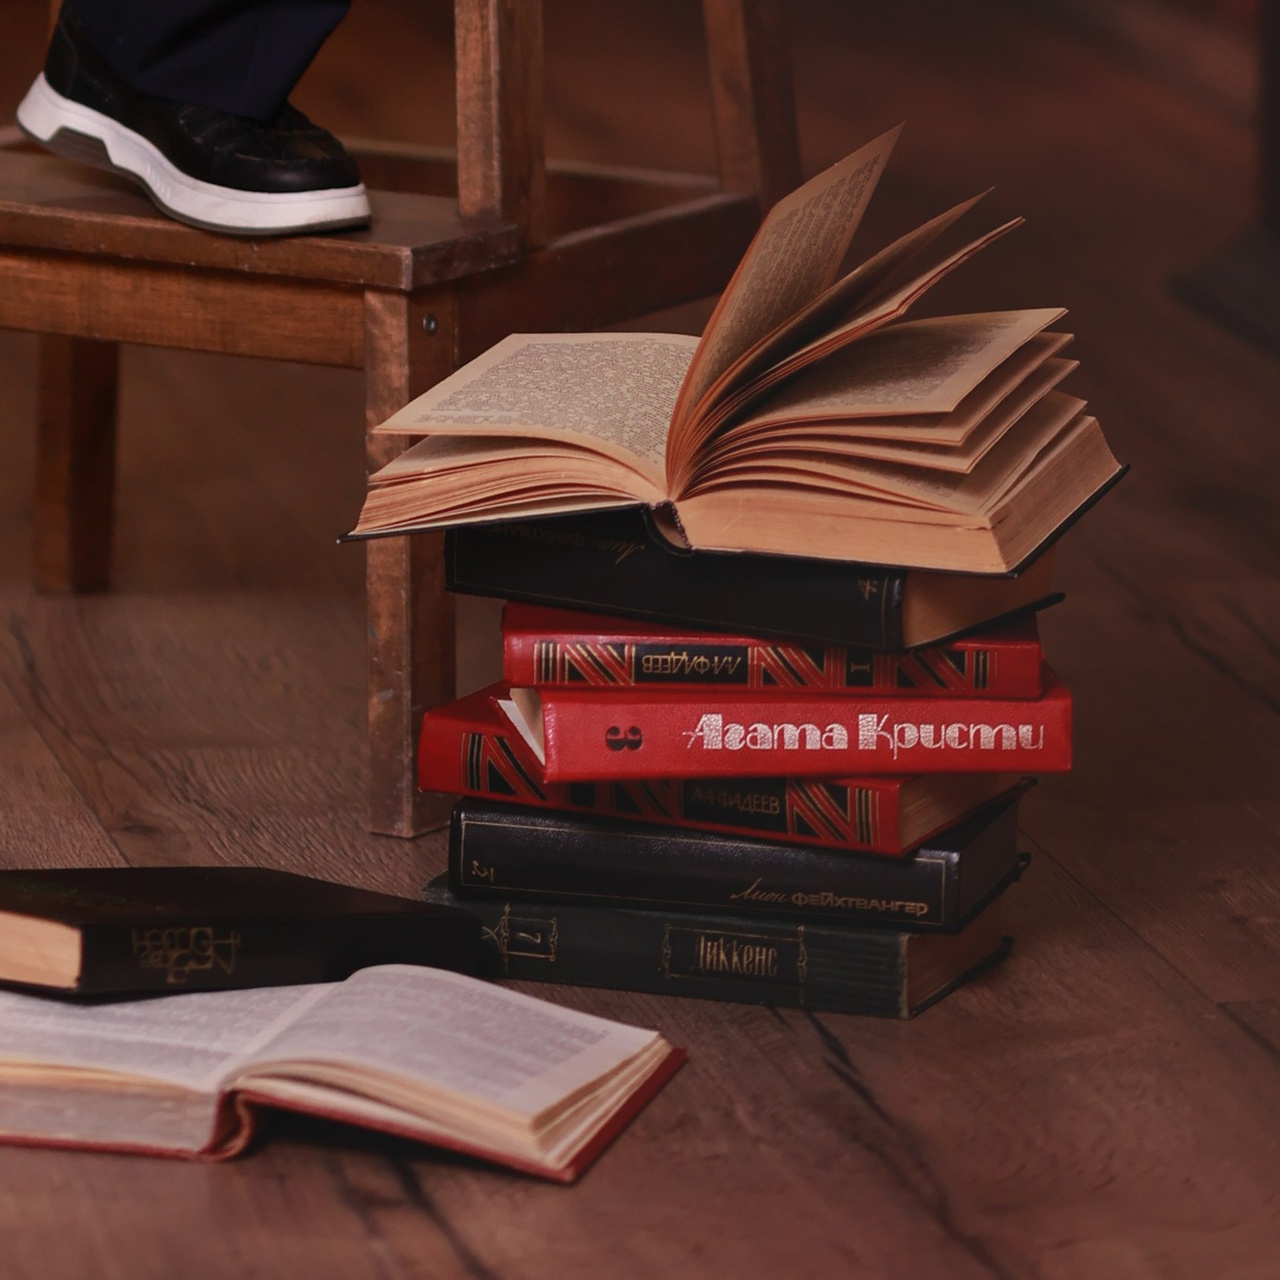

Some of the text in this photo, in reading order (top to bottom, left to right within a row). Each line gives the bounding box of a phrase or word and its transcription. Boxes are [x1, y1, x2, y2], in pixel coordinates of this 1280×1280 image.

[681, 712, 849, 751] Агата
[857, 712, 1046, 760] Кристи
[729, 876, 790, 904] Лион
[790, 890, 930, 918] ФЕЙХТВАНГЕР
